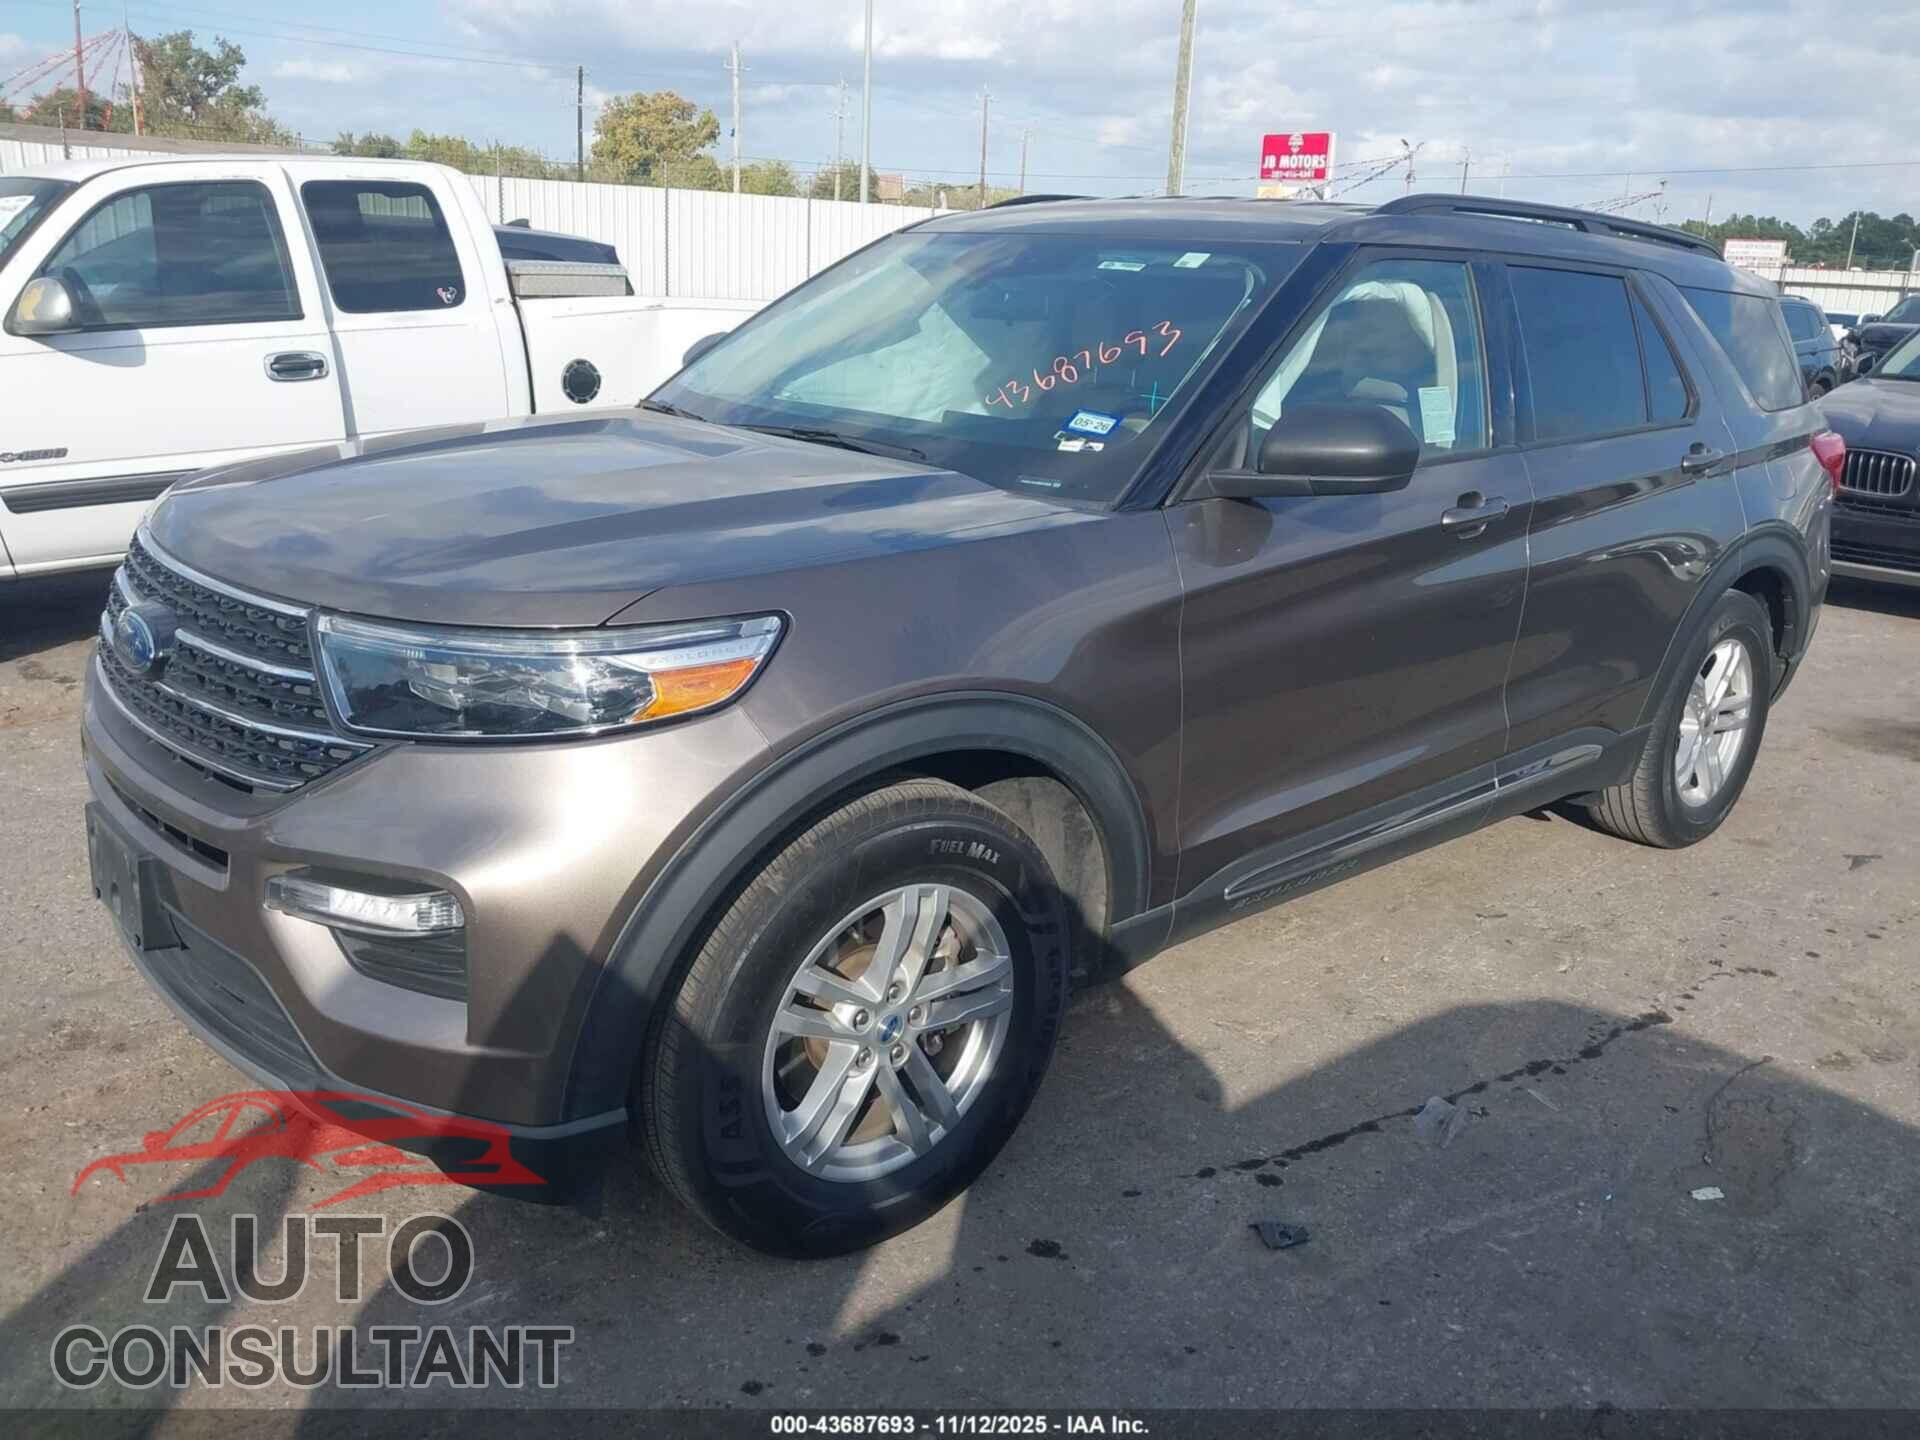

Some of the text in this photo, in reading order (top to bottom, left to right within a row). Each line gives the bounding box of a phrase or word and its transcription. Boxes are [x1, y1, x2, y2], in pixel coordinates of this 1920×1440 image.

[1262, 153, 1327, 169] JB MOTORS
[985, 320, 1183, 408] 43687693
